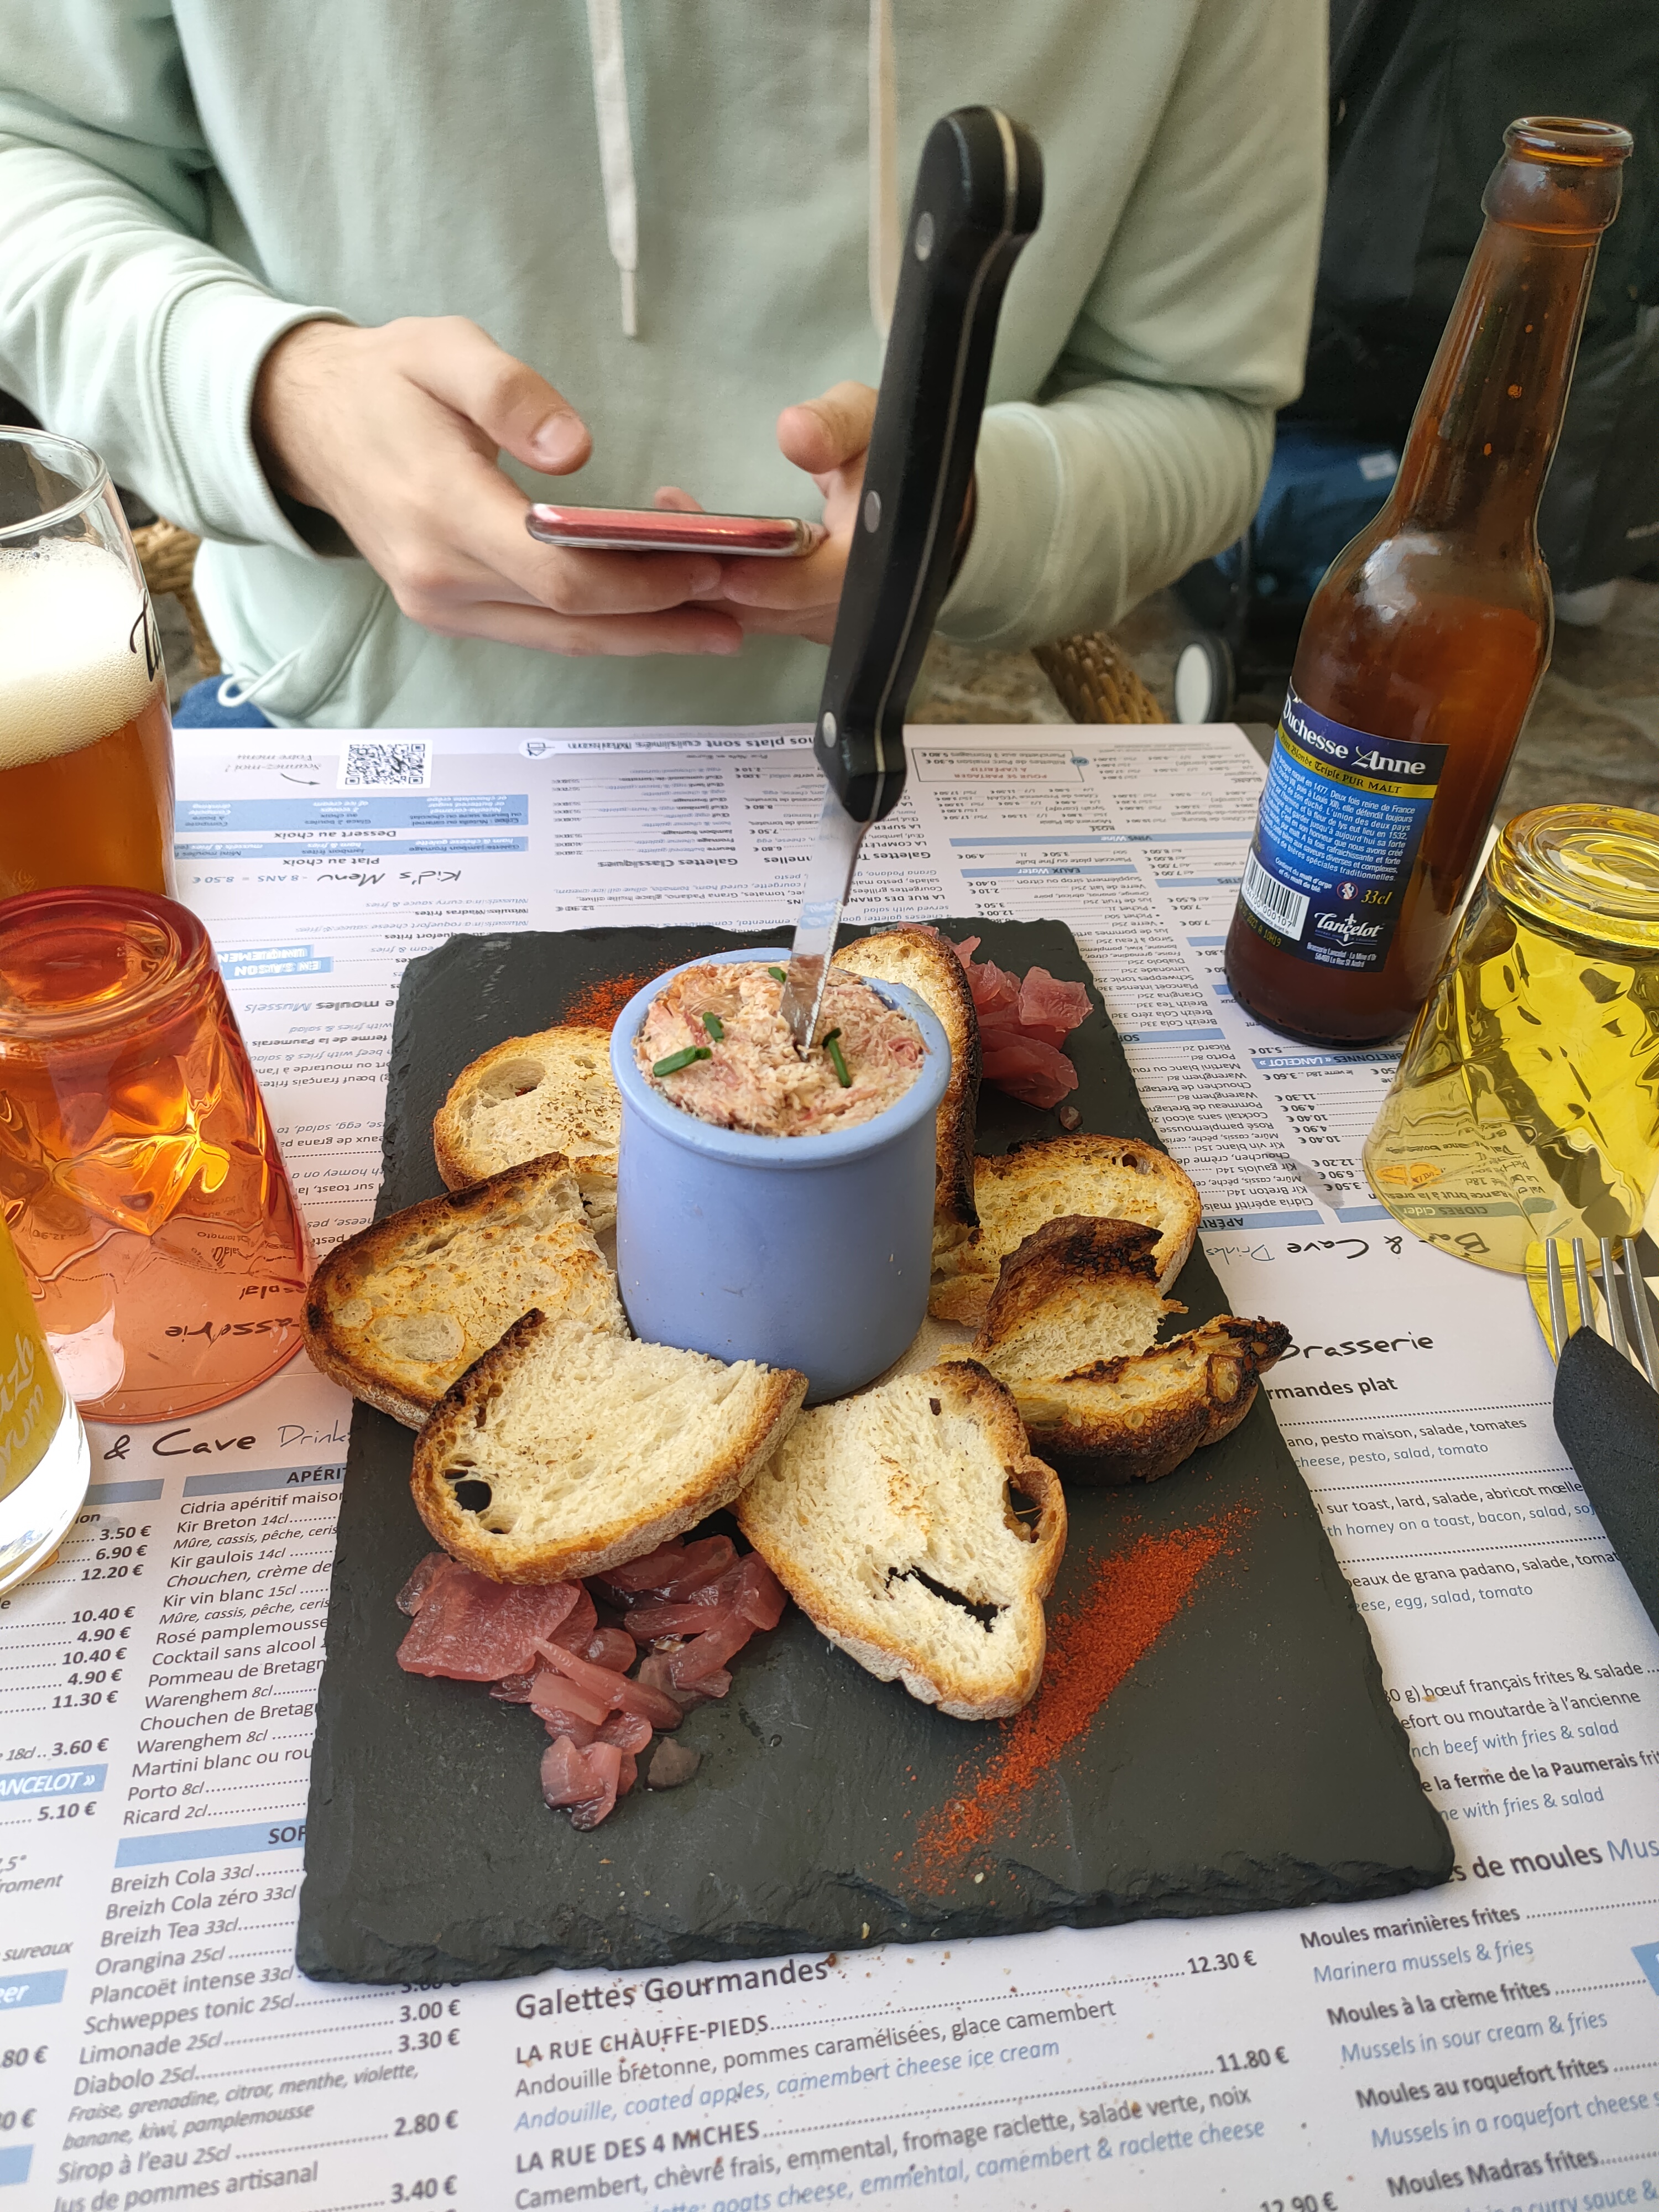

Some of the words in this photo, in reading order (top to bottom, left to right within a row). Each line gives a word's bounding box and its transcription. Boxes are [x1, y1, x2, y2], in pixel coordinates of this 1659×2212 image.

[745, 738, 785, 748] plats
[1283, 698, 1349, 759] Duchesse
[1352, 745, 1426, 775] Anne
[1342, 776, 1363, 787] PUR
[1369, 782, 1402, 794] MALT
[1330, 790, 1347, 802] Deux
[1348, 795, 1360, 806] fois
[1361, 800, 1379, 810] reine
[1381, 804, 1390, 812] de
[1391, 805, 1415, 814] France
[877, 852, 931, 860] Galettes
[1306, 853, 1338, 872] spéciales
[1340, 866, 1396, 881] traditionnelles.
[317, 873, 386, 887] Menu
[399, 870, 462, 885] Kid's
[1361, 889, 1392, 905] 33cl
[233, 962, 294, 977] SAISON
[296, 961, 322, 972] EN
[244, 1003, 312, 1014] Mussels
[315, 1000, 380, 1011] moules
[1185, 1018, 1218, 1026] Breizh
[1268, 1057, 1324, 1067] LANCELOT
[1272, 1072, 1300, 1080] 3.60
[1192, 1091, 1259, 1100] Warenghem
[1159, 1121, 1245, 1133] pamplemousse
[1246, 1122, 1275, 1131] Rosé
[313, 1185, 350, 1194] toast,
[1205, 1244, 1275, 1265] Drinks
[1286, 1238, 1369, 1259] Cave
[1383, 1235, 1403, 1255] &
[1279, 1331, 1434, 1361] rasserie
[1358, 1377, 1399, 1396] plat
[103, 1434, 131, 1460] &
[152, 1428, 257, 1457] Cave
[278, 1419, 351, 1447] Drink
[1320, 1433, 1359, 1447] pesto
[1361, 1428, 1417, 1441] maison,
[1419, 1423, 1468, 1436] salade,
[1469, 1420, 1527, 1432] tomates
[180, 1500, 226, 1515] Cidria
[230, 1494, 289, 1512] apéritif
[1327, 1504, 1348, 1514] sur
[1352, 1499, 1394, 1511] toast,
[1395, 1494, 1430, 1508] lard,
[1432, 1490, 1483, 1505] salade,
[1485, 1486, 1537, 1500] abricot
[99, 1526, 137, 1541] 3.50
[140, 1525, 152, 1537] €
[177, 1521, 200, 1533] Kir
[203, 1517, 257, 1531] Breton
[260, 1513, 289, 1526] 14cl
[173, 1537, 212, 1550] Mûre,
[217, 1532, 258, 1545] cassis,
[260, 1528, 304, 1543] pêche,
[1391, 1571, 1411, 1583] de
[1414, 1569, 1457, 1584] grana
[1459, 1562, 1520, 1580] padano,
[1522, 1556, 1574, 1571] salade,
[163, 1594, 186, 1608] Kir
[190, 1592, 214, 1605] vin
[219, 1588, 264, 1603] blanc
[268, 1584, 297, 1598] 15cl
[1395, 1597, 1427, 1610] egg,
[1431, 1588, 1475, 1604] salad,
[1478, 1584, 1533, 1600] tomato
[156, 1628, 196, 1645] Rosé
[200, 1618, 328, 1644] pamplemousse
[152, 1646, 220, 1666] Cocktail
[223, 1646, 261, 1659] sans
[266, 1636, 316, 1655] alcool
[1469, 1674, 1532, 1693] français
[1532, 1671, 1575, 1686] frites
[1576, 1667, 1593, 1681] &
[1594, 1661, 1644, 1679] salade
[145, 1688, 248, 1709] Warenghem
[252, 1684, 274, 1698] 8cl
[1443, 1712, 1465, 1725] ou
[1468, 1700, 1547, 1722] moutarde
[1548, 1698, 1560, 1712] à
[0, 1772, 84, 1796] ANCELOT
[37, 1802, 80, 1822] 5.10
[84, 1801, 97, 1816] €
[123, 1804, 181, 1825] Ricard
[184, 1803, 208, 1819] 2cl
[1472, 1855, 1506, 1879] de
[1509, 1845, 1603, 1874] moules
[1300, 1926, 1370, 1949] Moules
[1373, 1914, 1470, 1939] marinières
[1471, 1907, 1521, 1926] frites
[95, 1950, 186, 1976] Orangina
[190, 1945, 226, 1965] 25cl
[1187, 1952, 1240, 1974] 12.30
[1243, 1950, 1258, 1966] €
[1313, 1960, 1397, 1984] Marinera
[1402, 1946, 1472, 1971] mussels
[1476, 1943, 1492, 1961] &
[1494, 1941, 1534, 1964] fries
[515, 1982, 635, 2020] Galettes
[645, 1958, 829, 2004] Gourmandes
[399, 2001, 443, 2023] 3.00
[447, 1999, 461, 2017] €
[1326, 2001, 1399, 2026] Moules
[1401, 1996, 1415, 2016] à
[1416, 1994, 1437, 2013] la
[1439, 1989, 1499, 2010] crème
[1500, 1981, 1551, 2002] frites
[515, 2067, 612, 2098] Andouille
[618, 2058, 717, 2084] bretonne,
[723, 2044, 810, 2074] pommes
[815, 2024, 946, 2056] caramélisées,
[951, 2017, 1001, 2042] glace
[1006, 2000, 1117, 2028] camembert
[517, 2044, 544, 2066] LA
[550, 2037, 593, 2060] RUE
[516, 2151, 544, 2174] LA
[551, 2143, 597, 2168] RUE
[604, 2136, 646, 2161] DES
[653, 2133, 666, 2153] 4
[672, 2120, 760, 2151] MICHES
